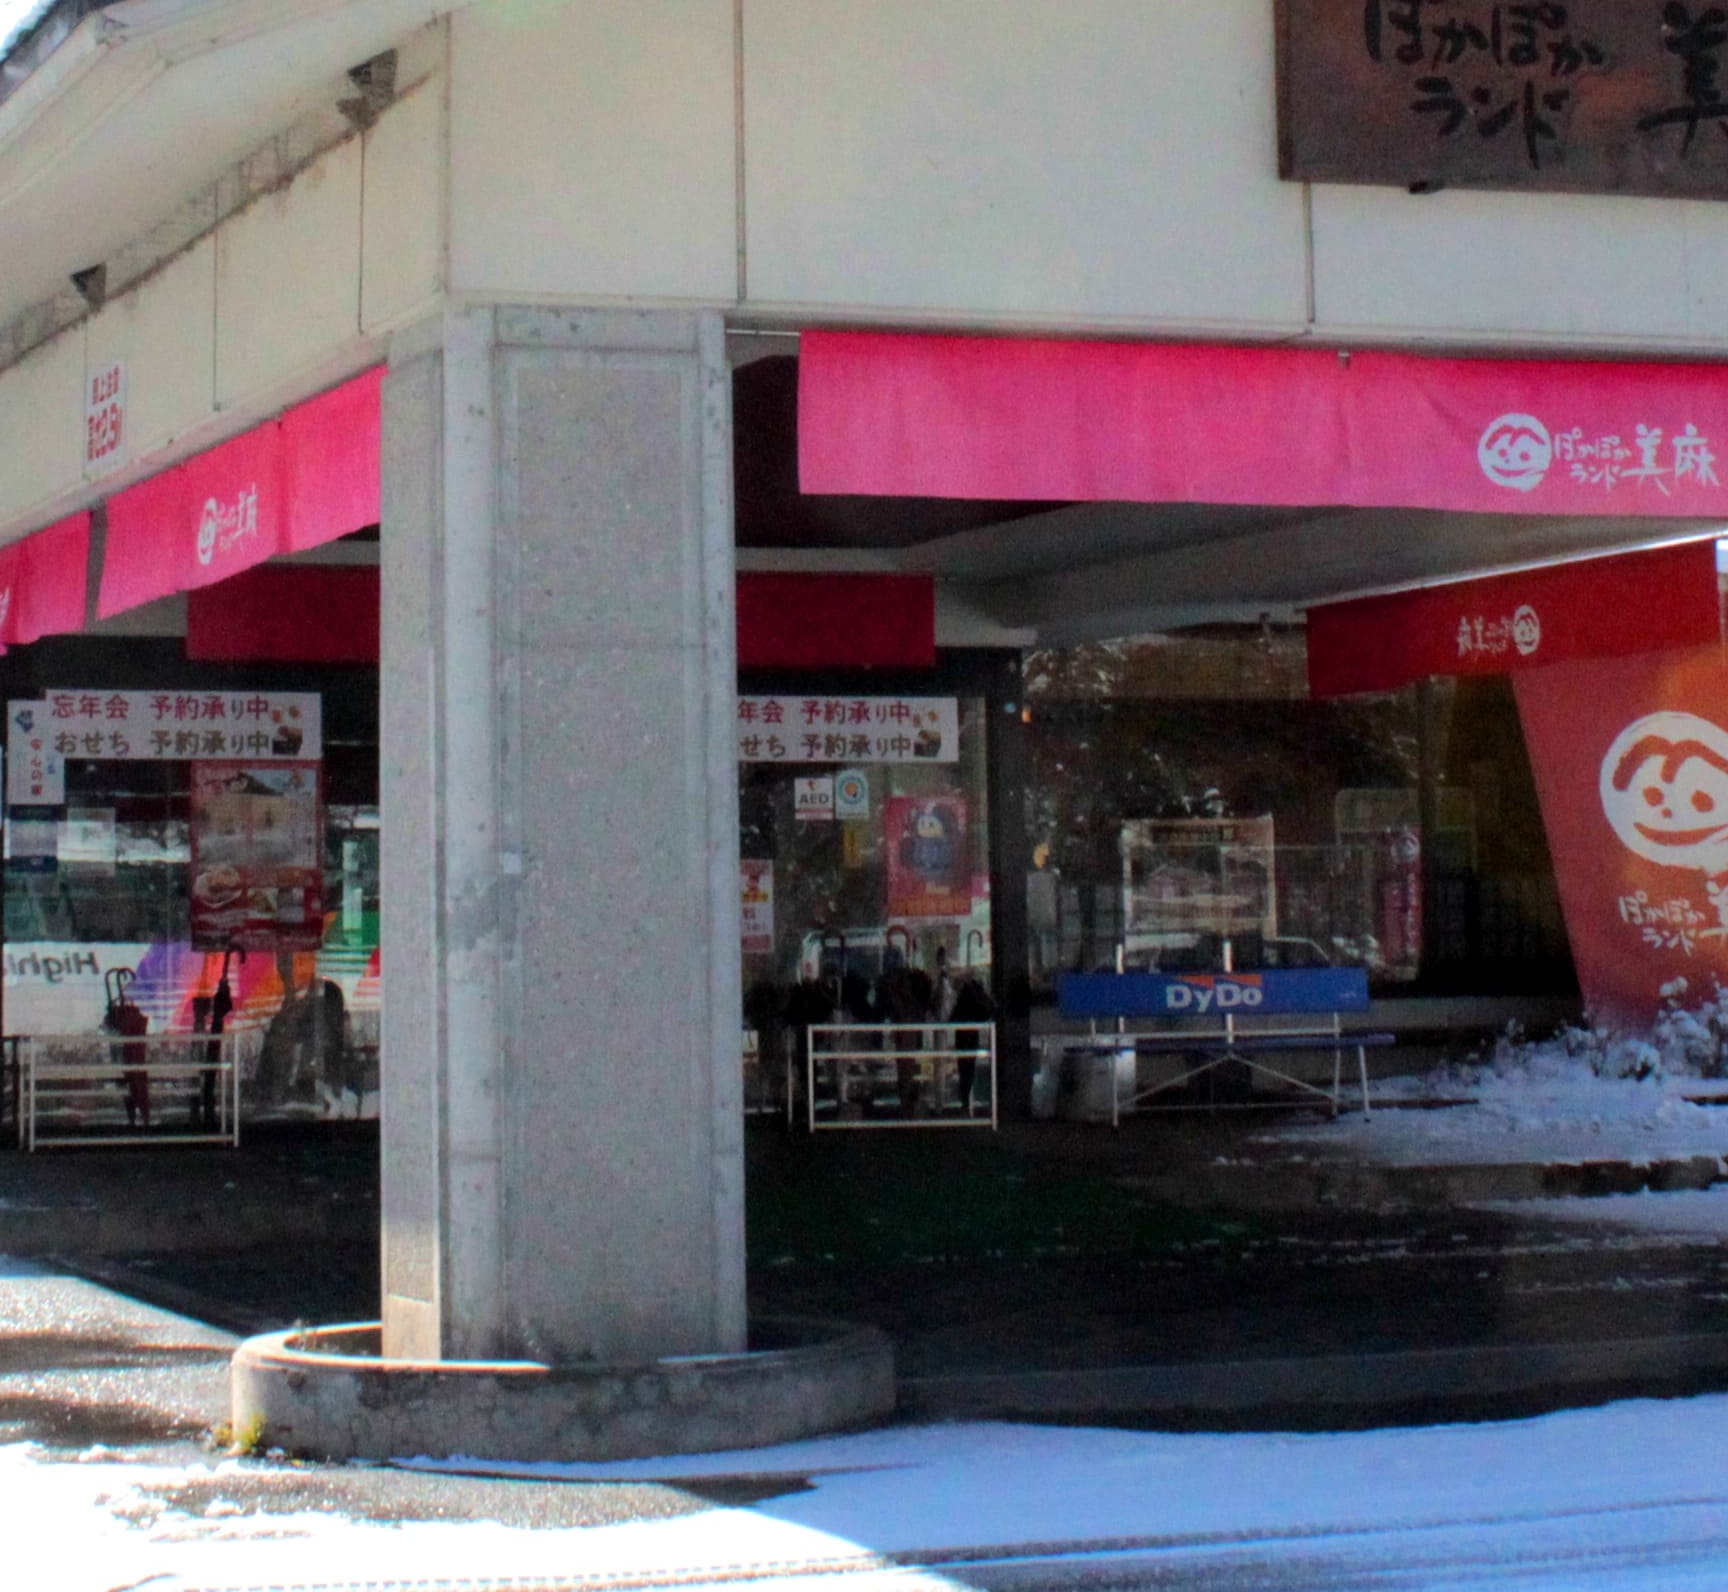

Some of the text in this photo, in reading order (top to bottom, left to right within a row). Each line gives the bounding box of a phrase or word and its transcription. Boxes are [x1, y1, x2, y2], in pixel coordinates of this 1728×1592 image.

[1409, 76, 1570, 170] ランド
[1554, 426, 1632, 460] ぽかぽか
[1621, 423, 1720, 497] 美麻
[1570, 463, 1621, 492] ランド
[52, 694, 270, 721] 忘年会 予約承り中
[800, 700, 910, 724] 予約承り中
[55, 729, 270, 756] おせち 予約承り中
[801, 733, 911, 757] 予約承り中
[799, 792, 829, 804] AED
[1619, 890, 1706, 925] ぽかぽか
[1642, 927, 1697, 957] ランド
[1166, 984, 1262, 1012] DyDo
